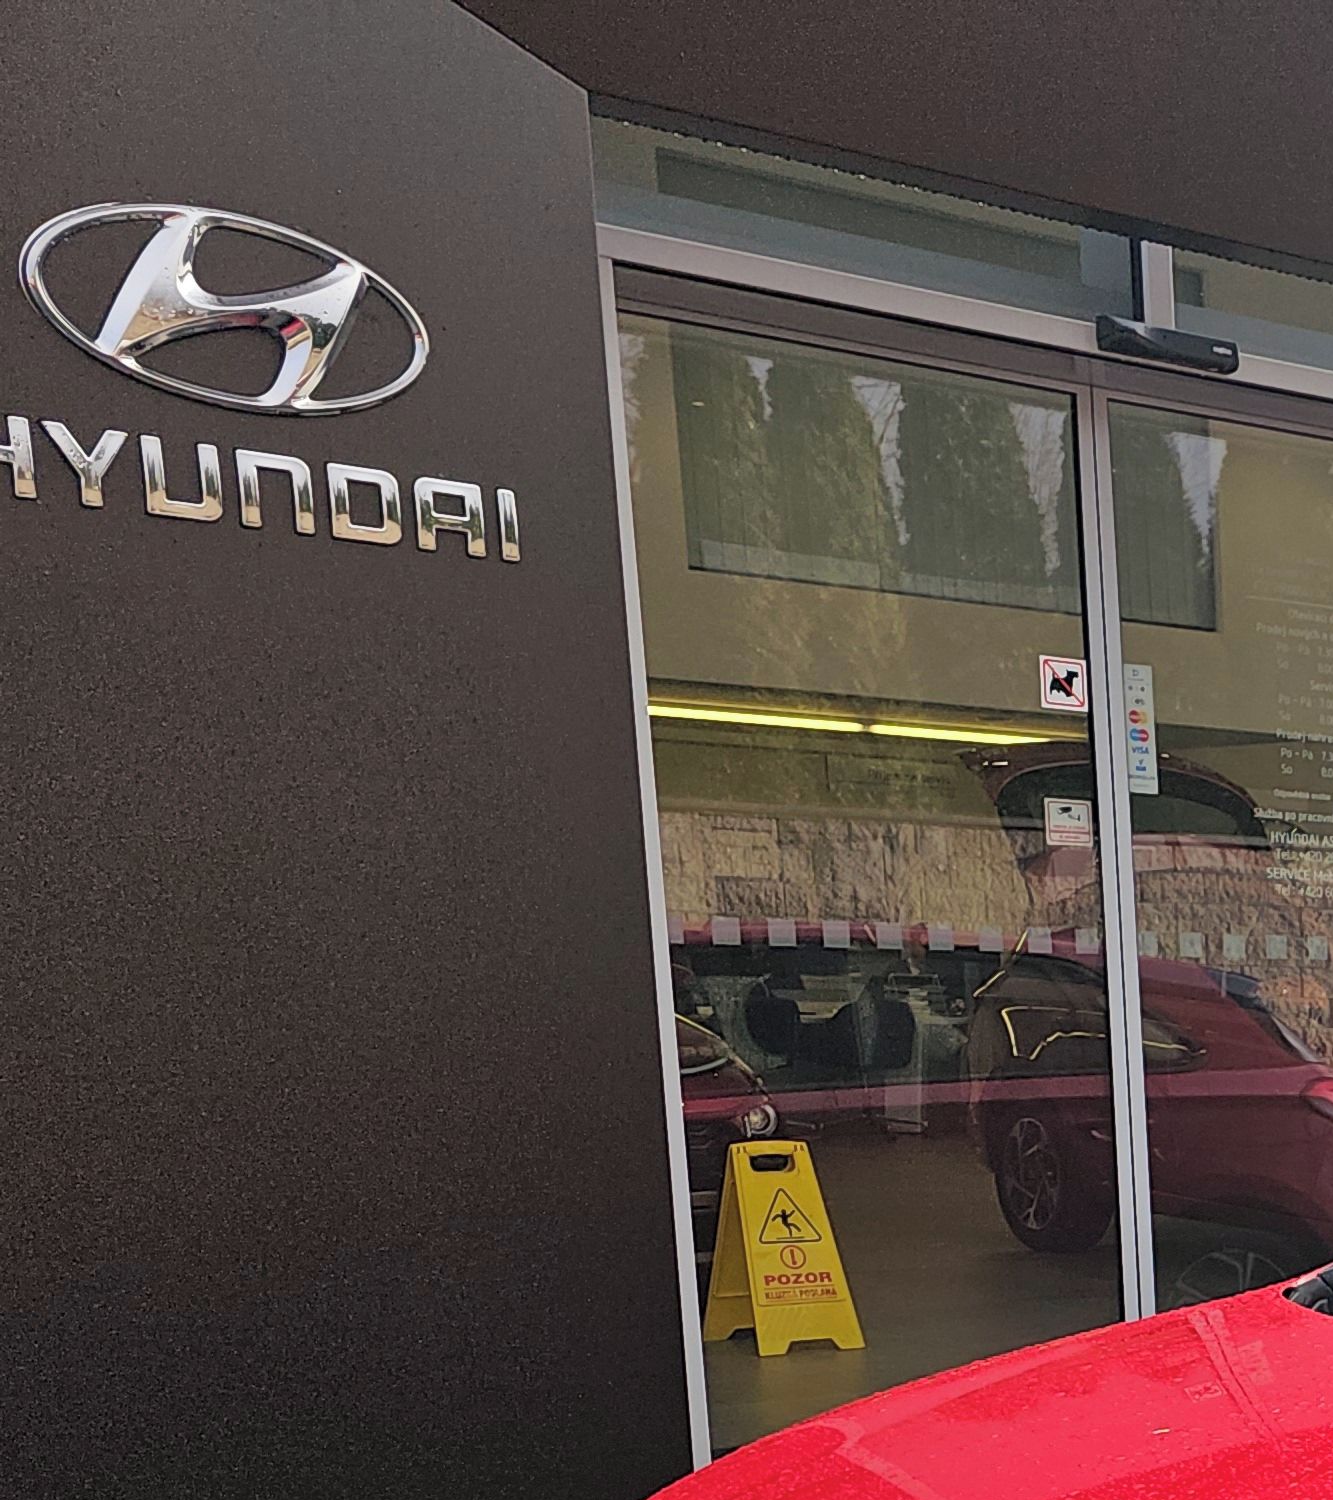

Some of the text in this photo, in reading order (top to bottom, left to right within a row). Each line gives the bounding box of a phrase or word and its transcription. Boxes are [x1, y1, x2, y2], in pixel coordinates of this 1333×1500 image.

[0, 415, 521, 562] HYUNDAI
[1131, 746, 1150, 755] VISA
[1280, 747, 1293, 759] Po
[1301, 749, 1314, 761] Pá
[1280, 763, 1293, 775] So
[1270, 831, 1319, 847] HYUNDAI
[1266, 866, 1311, 881] SERVICE
[764, 1272, 833, 1286] POZOR
